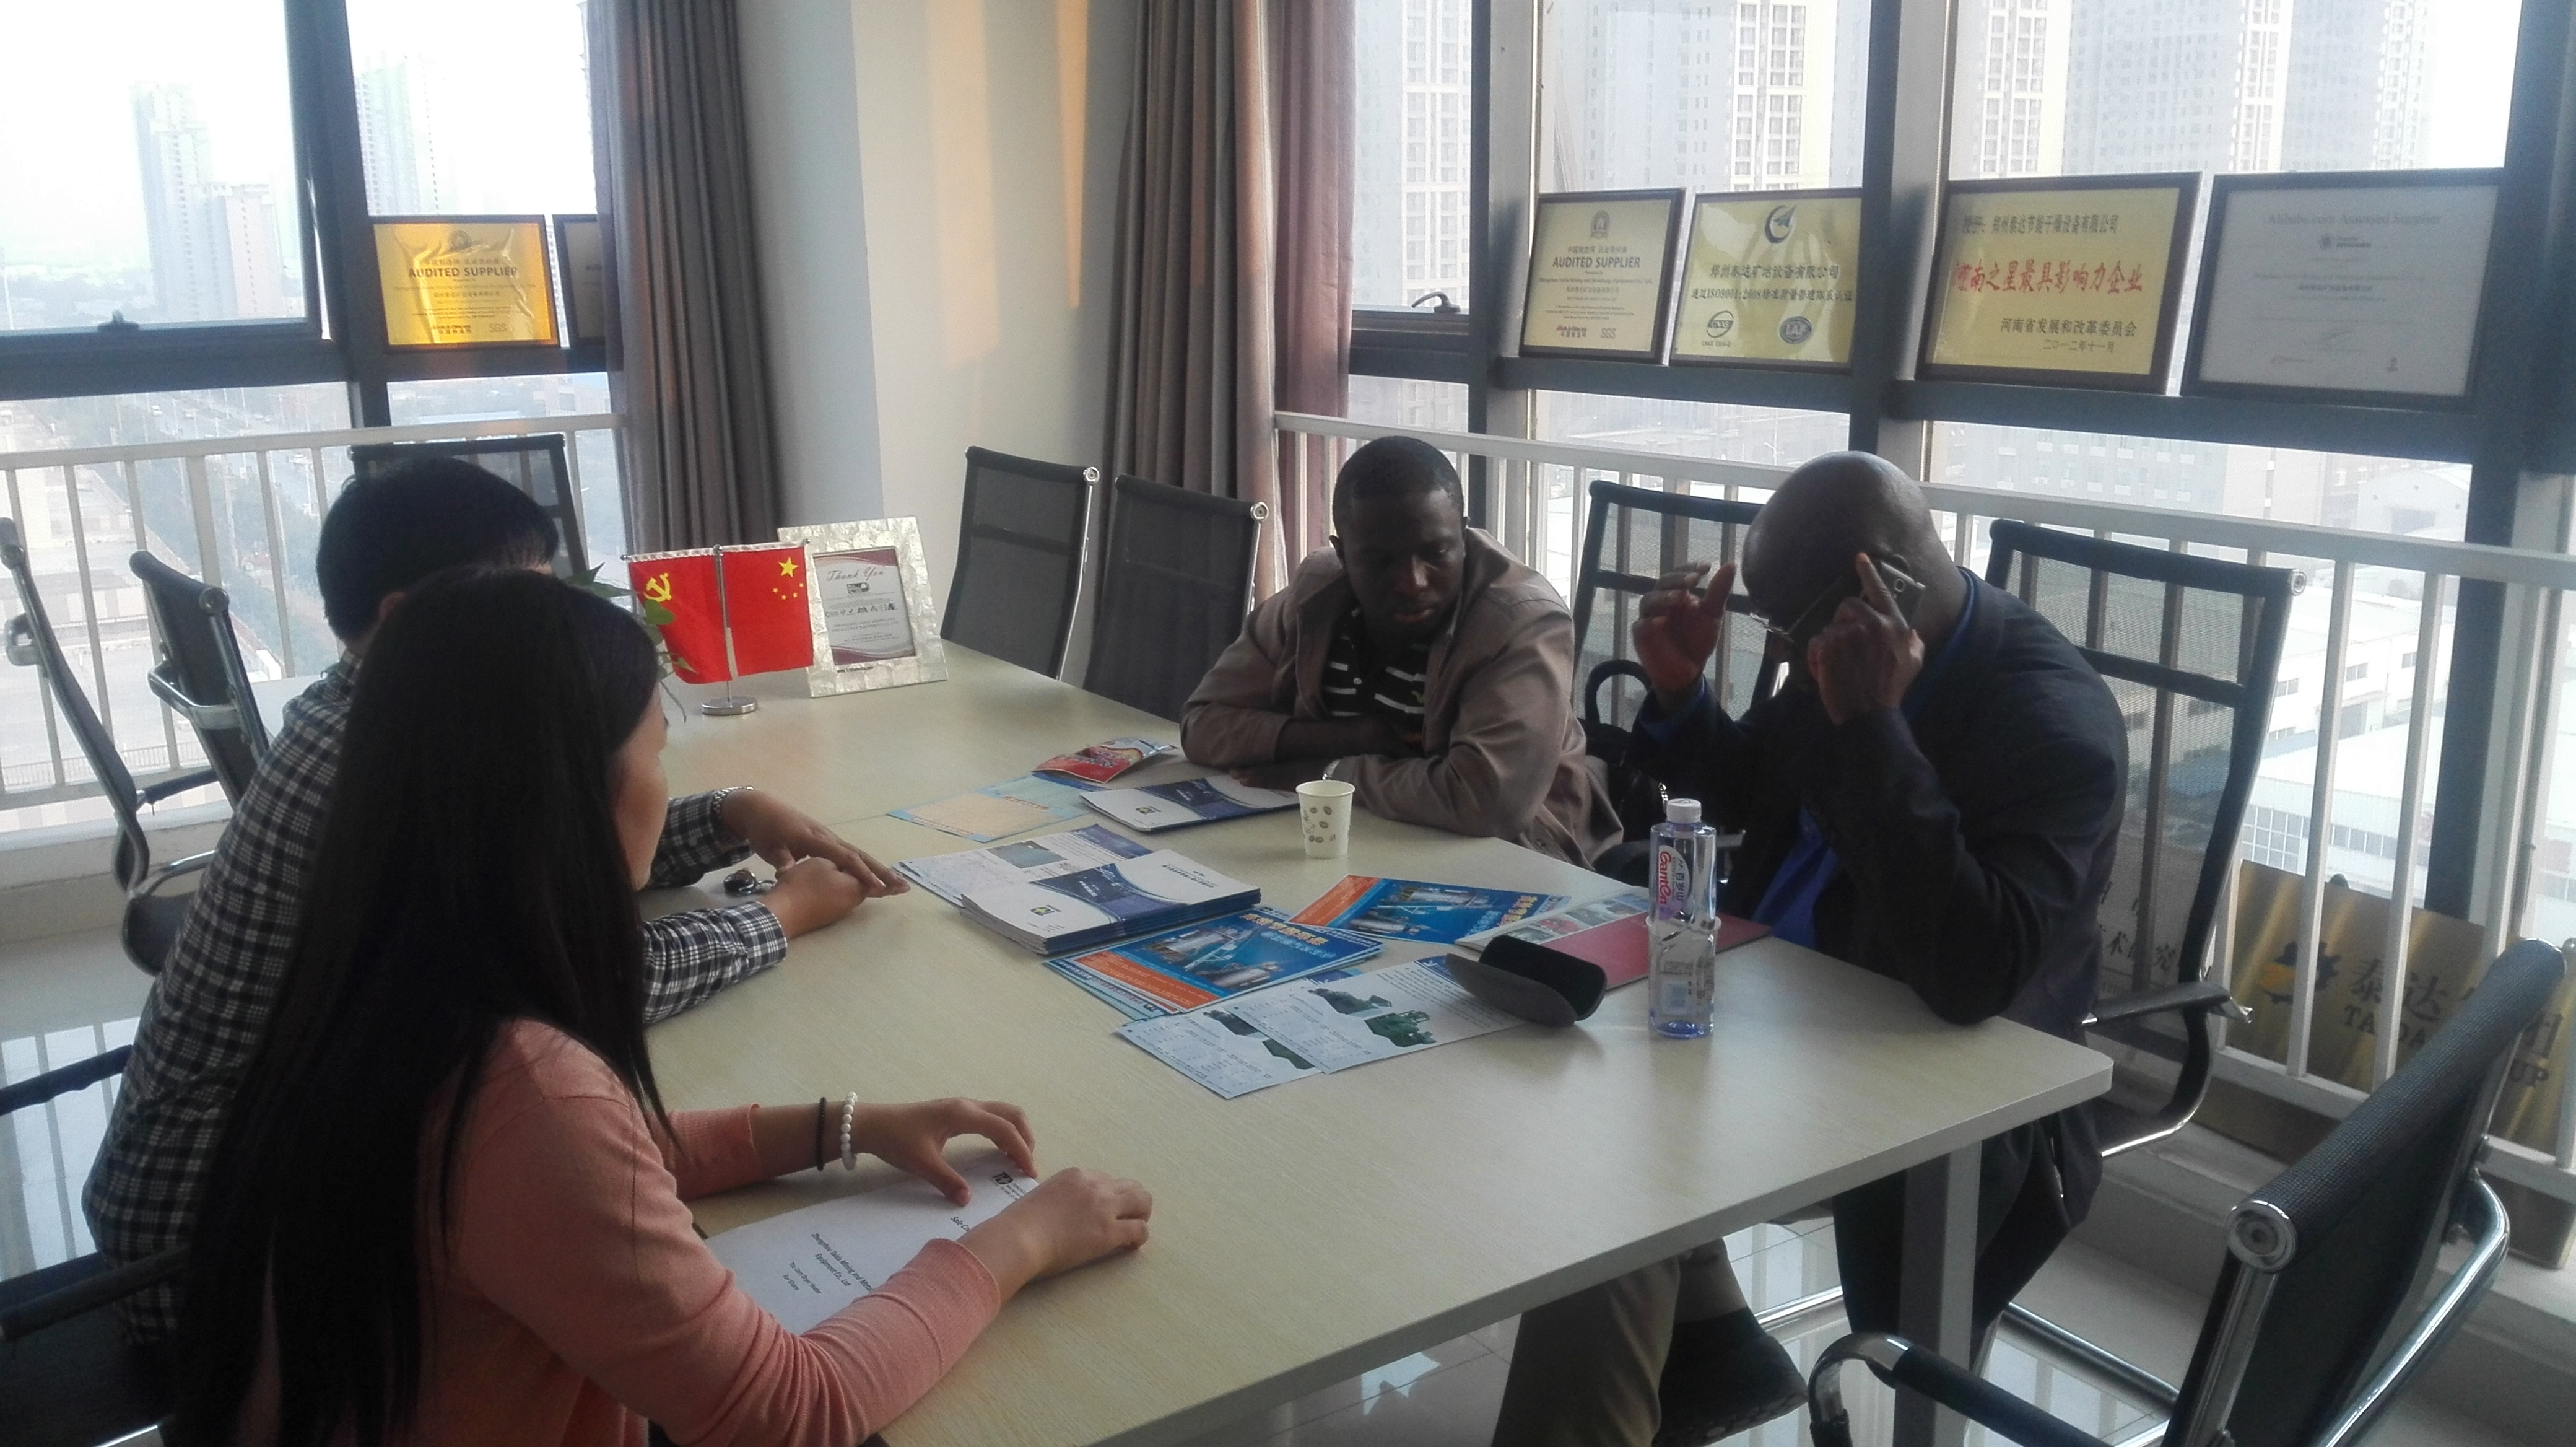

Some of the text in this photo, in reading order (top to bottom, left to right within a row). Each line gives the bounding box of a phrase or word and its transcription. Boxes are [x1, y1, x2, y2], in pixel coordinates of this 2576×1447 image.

[1552, 256, 1640, 268] AUDITED SUPPLIER
[409, 266, 518, 278] AUDITED SUPPLIER
[489, 323, 507, 333] SGS
[1601, 327, 1616, 339] SGS
[2000, 317, 2137, 337] 河南省发展和改革委员会
[826, 566, 884, 582] Thank You
[815, 1253, 837, 1273] Equipment
[840, 1260, 855, 1274] Mining
[852, 1272, 864, 1281] and
